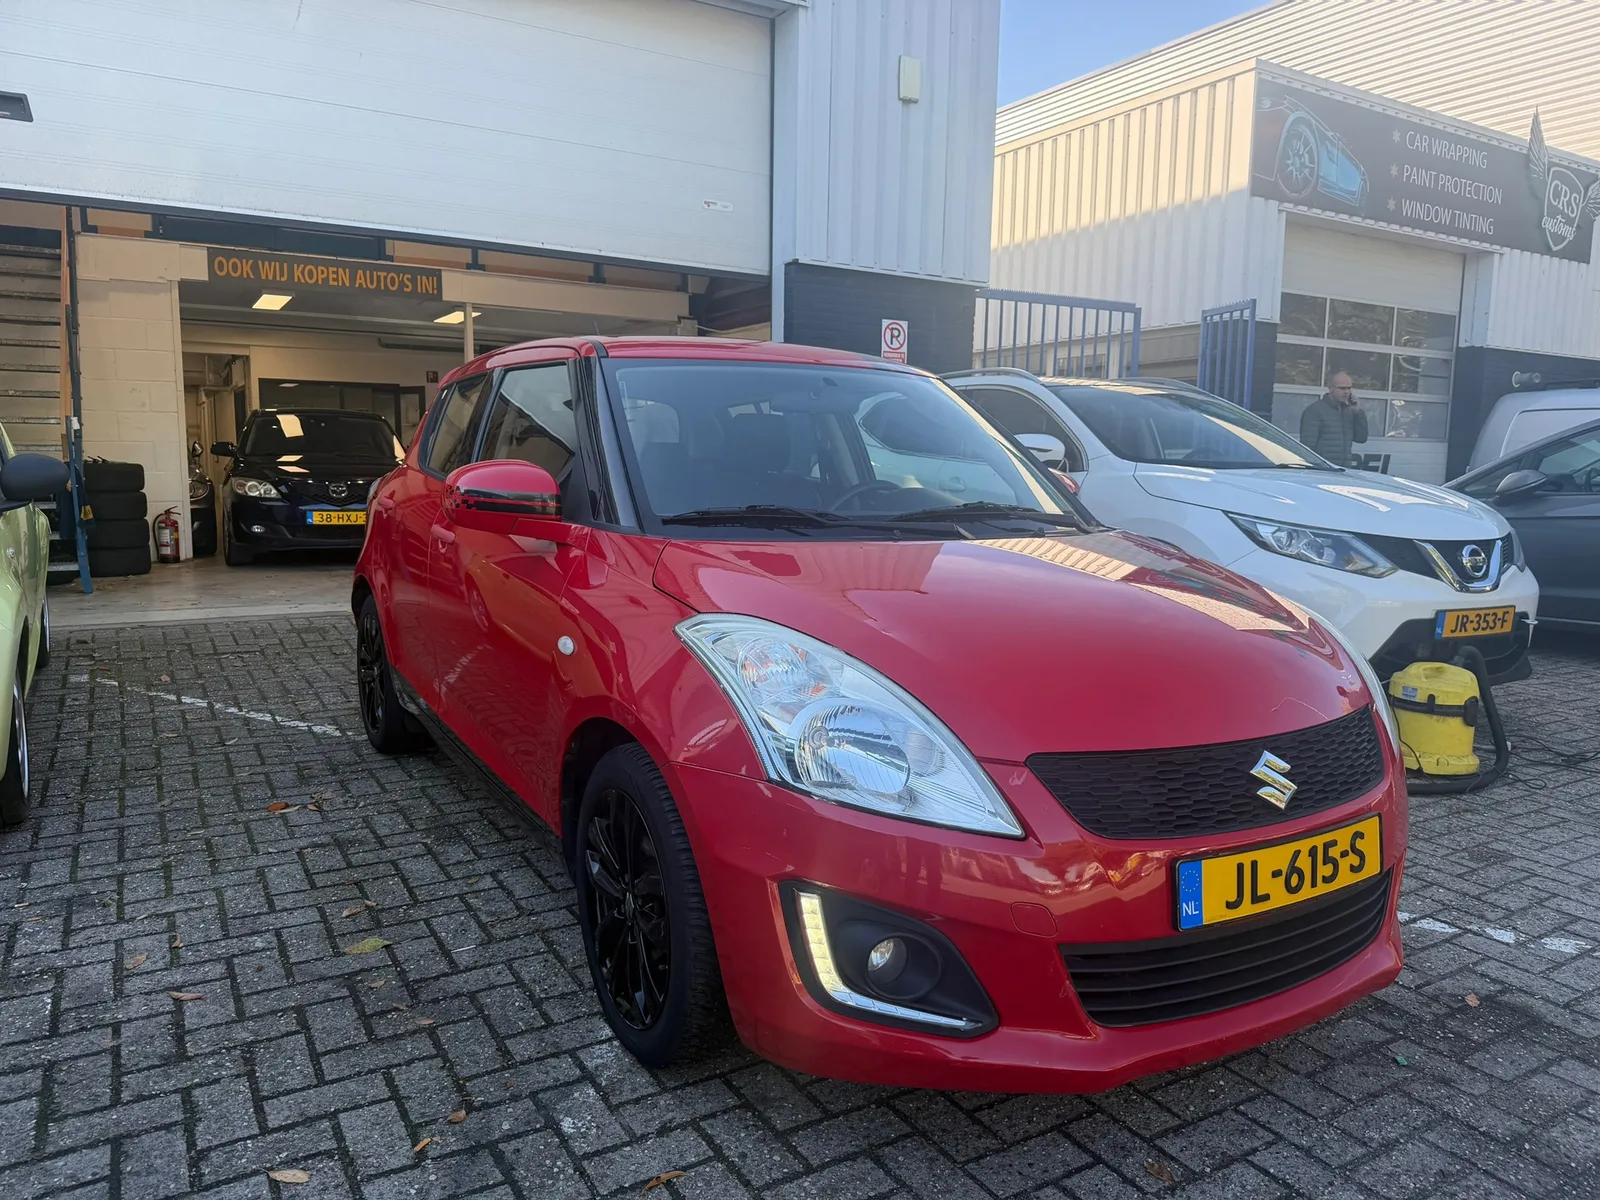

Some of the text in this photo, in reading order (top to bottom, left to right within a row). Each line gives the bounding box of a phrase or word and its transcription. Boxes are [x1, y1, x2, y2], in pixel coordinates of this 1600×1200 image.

[1406, 131, 1488, 169] CAR WRAPPING
[1403, 164, 1503, 205] PAINT PROTECTION
[1549, 180, 1580, 217] CRS
[1401, 198, 1494, 235] WINDOW TINTING
[213, 256, 438, 295] OOK WIJ KOPEN AUTO'S IN!
[1450, 611, 1509, 633] JR-353-F
[1225, 830, 1366, 910] JL-615-S
[1182, 901, 1199, 917] NL
